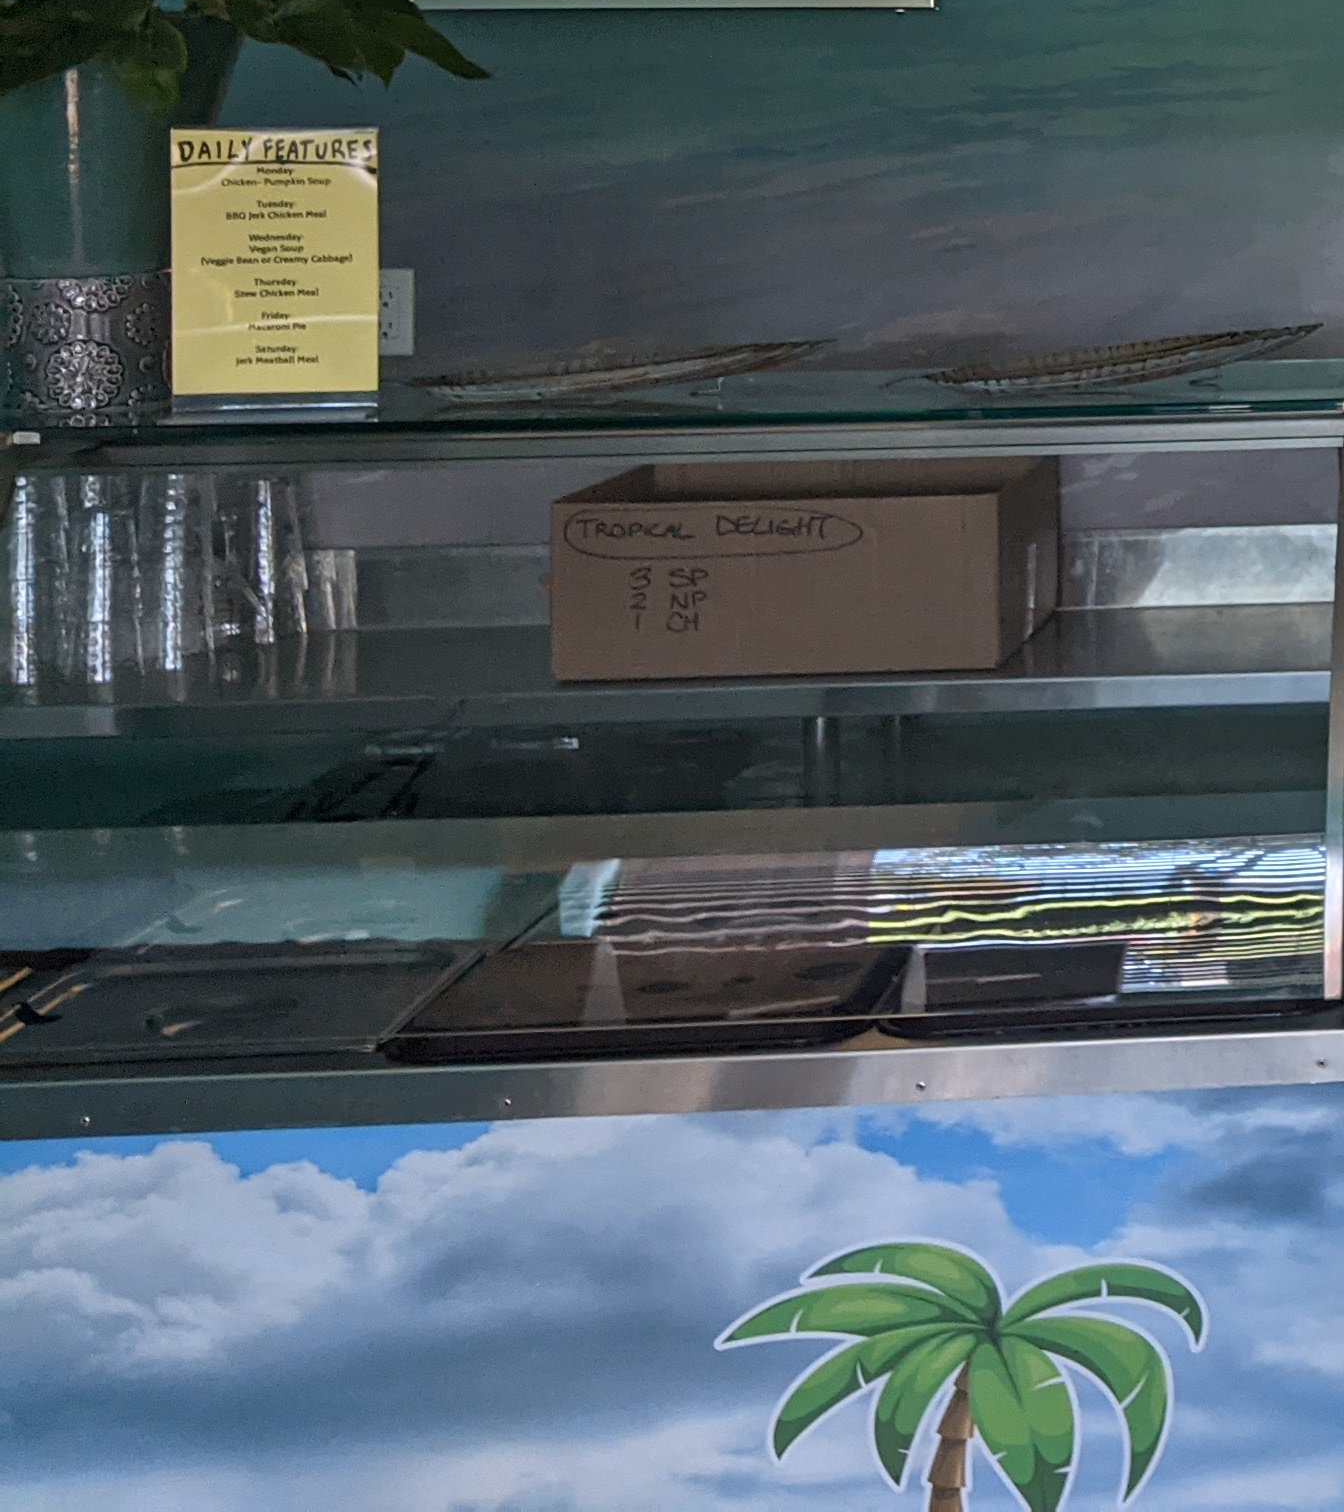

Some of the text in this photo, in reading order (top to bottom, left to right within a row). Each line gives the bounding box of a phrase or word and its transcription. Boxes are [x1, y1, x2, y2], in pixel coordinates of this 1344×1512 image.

[177, 137, 373, 161] DAILY FEATURES
[716, 513, 835, 539] DELIGHT
[669, 567, 707, 587] SP
